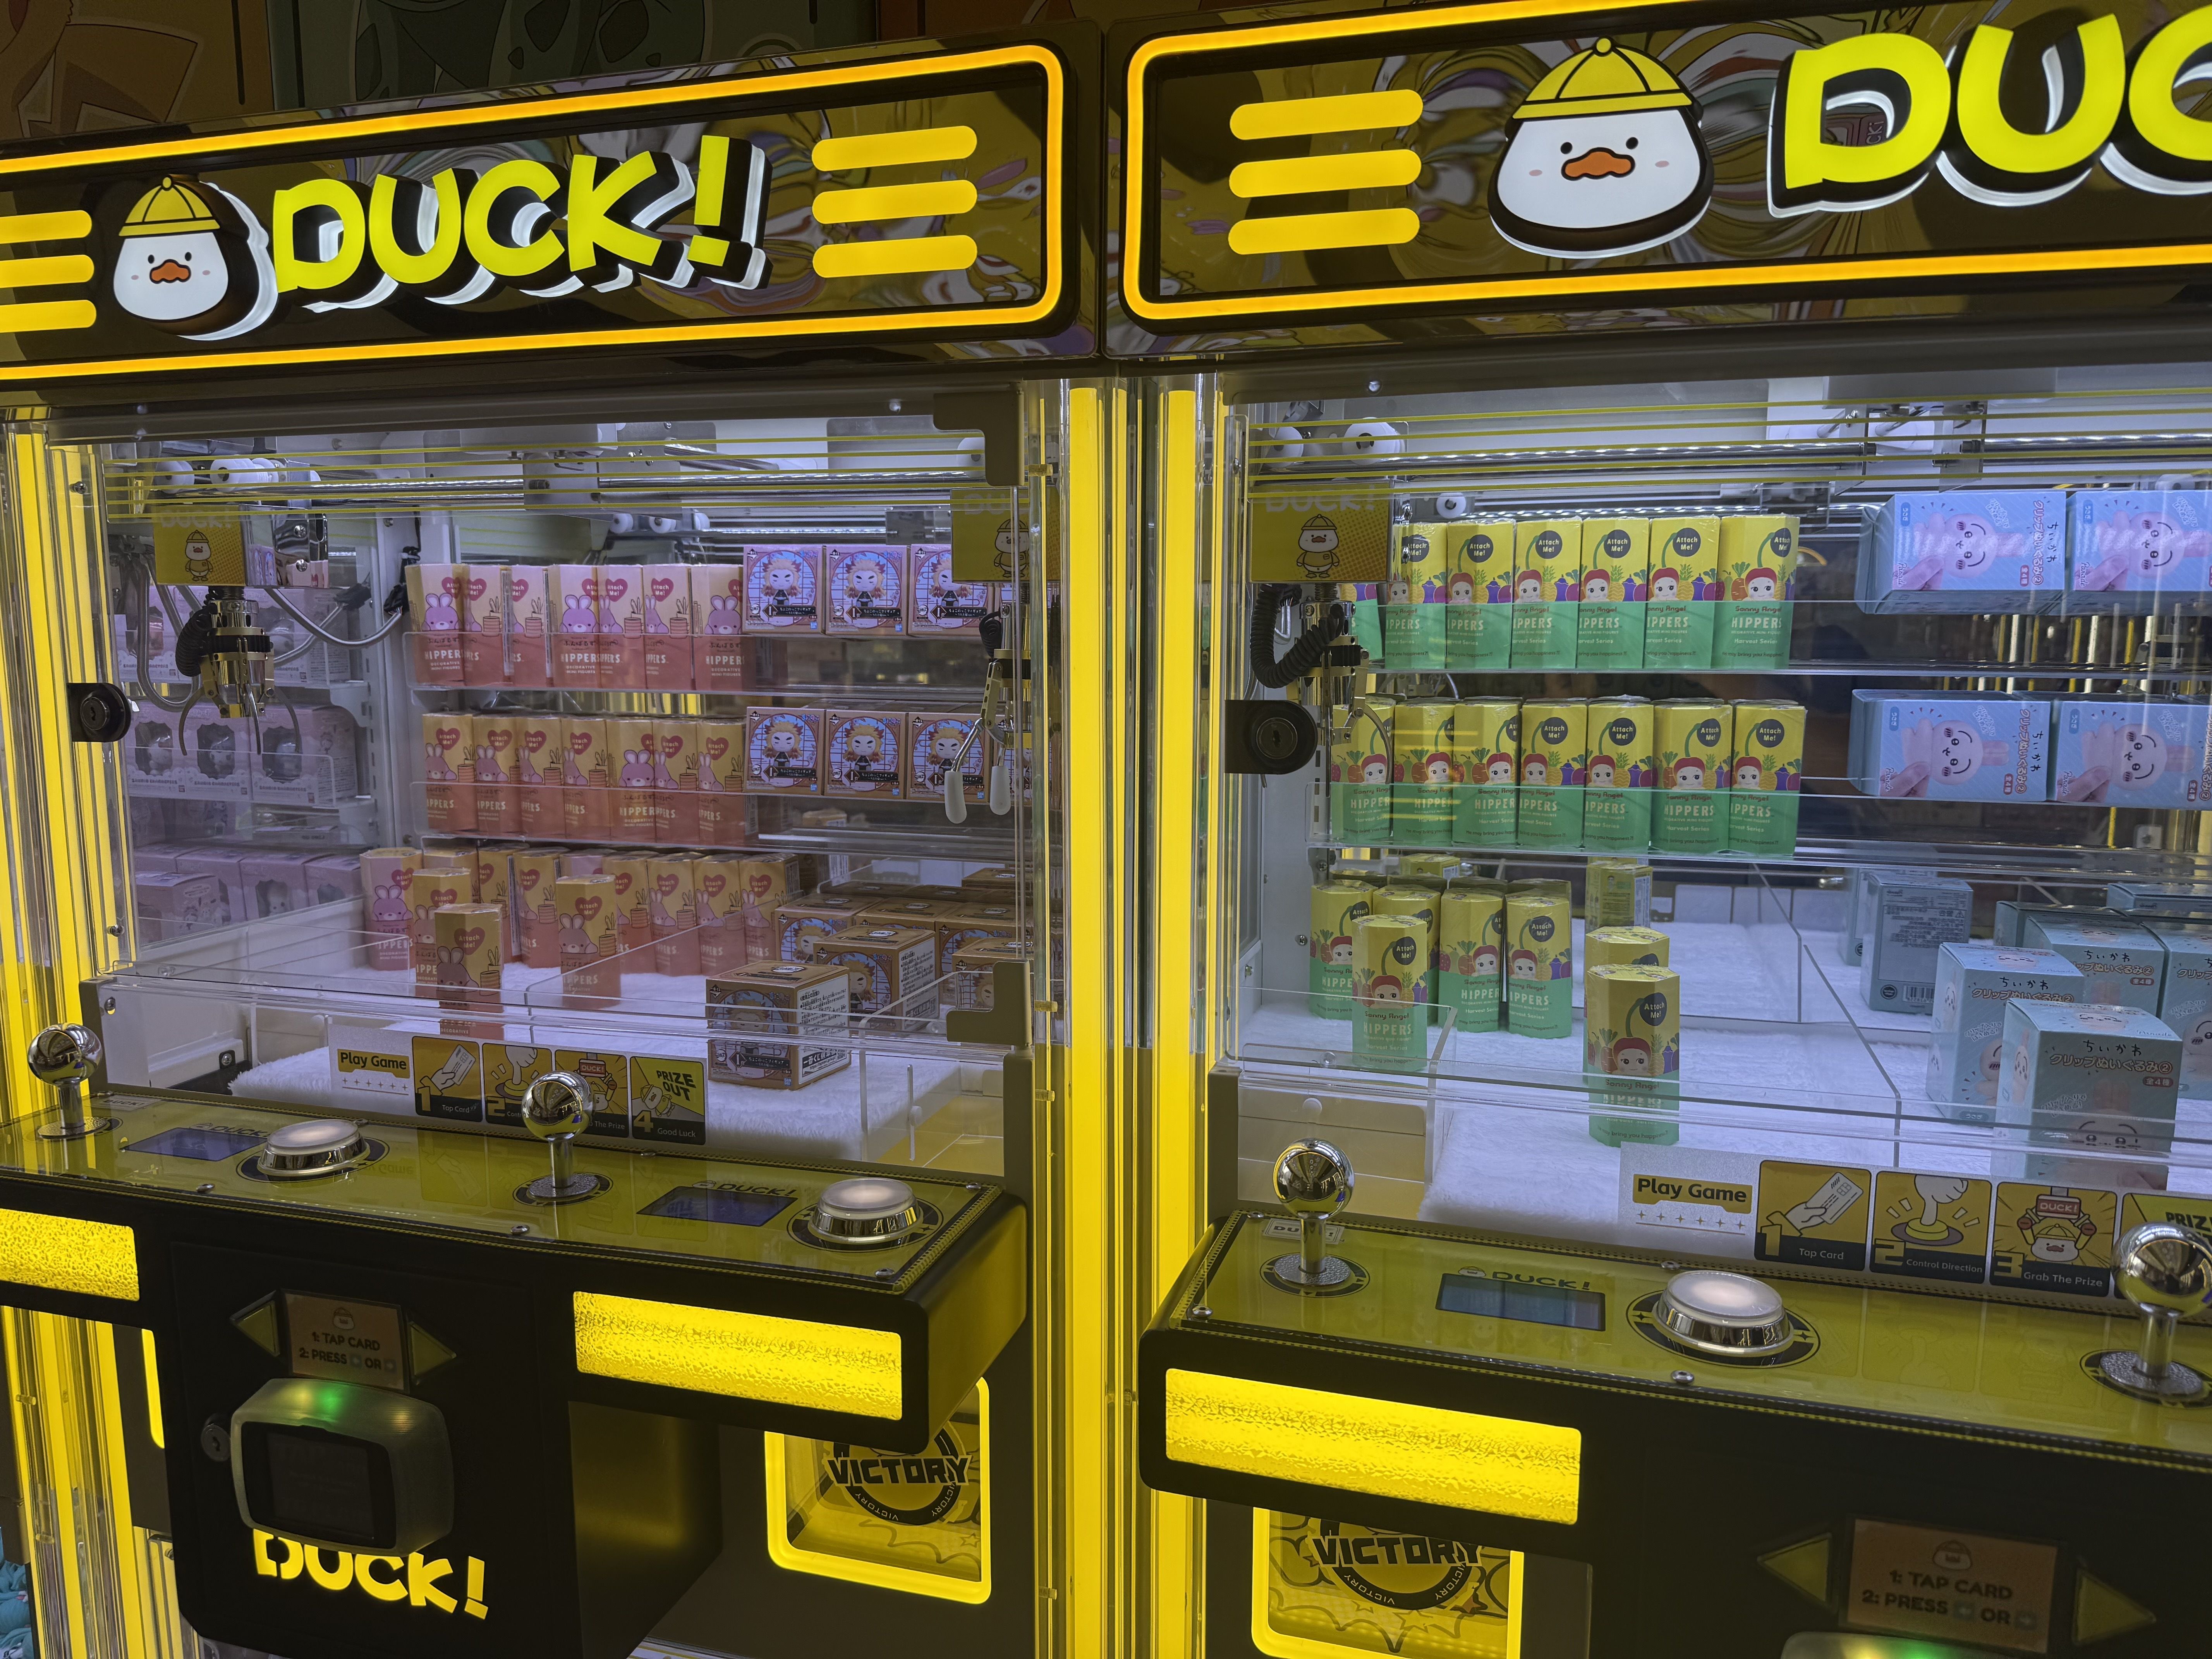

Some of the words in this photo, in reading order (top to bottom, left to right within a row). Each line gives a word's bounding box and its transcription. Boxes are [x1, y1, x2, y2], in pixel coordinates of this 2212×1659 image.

[273, 136, 729, 292] DUCK!
[2047, 521, 2059, 563] ちいかわ
[1447, 620, 1484, 631] IPPERS
[1513, 618, 1552, 629] IPPERS
[1579, 617, 1619, 628] IPPERS
[1647, 617, 1688, 627] IPPERS
[2030, 730, 2044, 772] ちいかわ
[2063, 771, 2073, 795] Parade
[1475, 798, 1515, 809] HIPPER
[1520, 799, 1558, 811] IPPERS
[1586, 801, 1625, 814] IPPERS
[1731, 803, 1771, 817] IPPERS
[2084, 950, 2130, 962] ちいかわ
[1999, 977, 2049, 990] ちいかわ
[1461, 988, 1499, 1000] HIPPER
[1644, 1002, 1664, 1010] Attach
[1365, 1011, 1386, 1020] Sonny
[1364, 1021, 1412, 1035] HIPPERS
[2083, 1040, 2142, 1057] ちいかわ
[340, 1052, 368, 1068] Play
[371, 1055, 407, 1070] Game
[2050, 1054, 2173, 1074] クリップぬいぐるみ②
[656, 1070, 696, 1088] PRIZE
[1606, 1079, 1632, 1090] Sonny
[1635, 1082, 1659, 1091] Angel
[663, 1081, 690, 1101] OUT
[634, 1110, 654, 1133] 4
[717, 1183, 797, 1196] DUCK!
[1638, 1178, 1683, 1199] Play
[1688, 1183, 1747, 1202] Game
[2040, 1202, 2078, 1213] DUCK!
[2165, 1212, 2212, 1232] PRIZ
[1799, 1249, 1817, 1259] Tap
[1820, 1250, 1844, 1260] Card
[1906, 1259, 1939, 1269] Control
[1942, 1262, 1983, 1273] Direction
[1492, 1271, 1590, 1290] DUCK!
[2023, 1272, 2049, 1282] Grab
[2052, 1274, 2072, 1284] The
[2075, 1277, 2103, 1287] Prize
[312, 1332, 319, 1342] 1:
[322, 1333, 345, 1345] TAP
[349, 1337, 380, 1351] CARD
[299, 1347, 309, 1358] 2:
[312, 1349, 347, 1364] PRESS
[365, 1357, 381, 1369] OR
[828, 1456, 971, 1485] VICTORY
[855, 1492, 899, 1522] VICTORY
[1312, 1537, 1483, 1565] VICTORY
[253, 1528, 488, 1619] DUCK!
[1344, 1574, 1395, 1605] VICTORY
[1889, 1570, 1903, 1584] 1:
[1908, 1571, 1949, 1590] TAP
[1955, 1579, 2013, 1600] CARD
[1861, 1590, 1880, 1606] 2:
[1884, 1592, 1948, 1615] PRESS
[1981, 1608, 2011, 1626] OR
